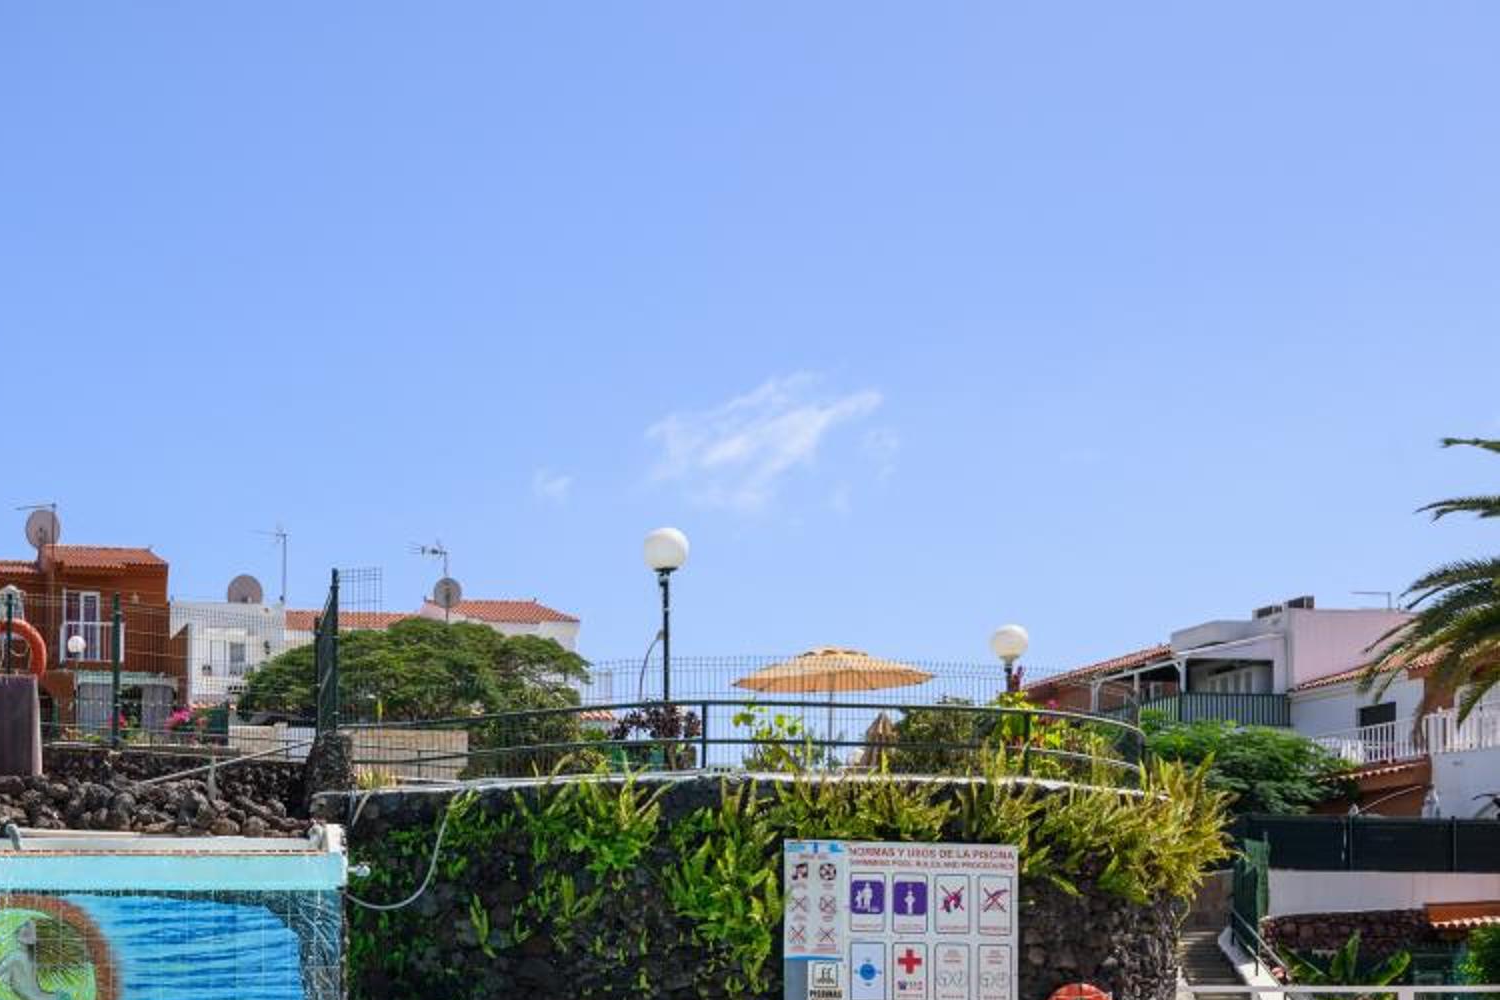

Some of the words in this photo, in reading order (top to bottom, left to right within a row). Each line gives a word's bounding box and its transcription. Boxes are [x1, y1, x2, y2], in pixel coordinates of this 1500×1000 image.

[849, 847, 895, 857] NORMAS
[897, 847, 905, 857] Y
[907, 848, 937, 858] USOS
[939, 849, 952, 859] DE
[957, 849, 971, 859] LA
[972, 849, 1015, 860] PISCINA
